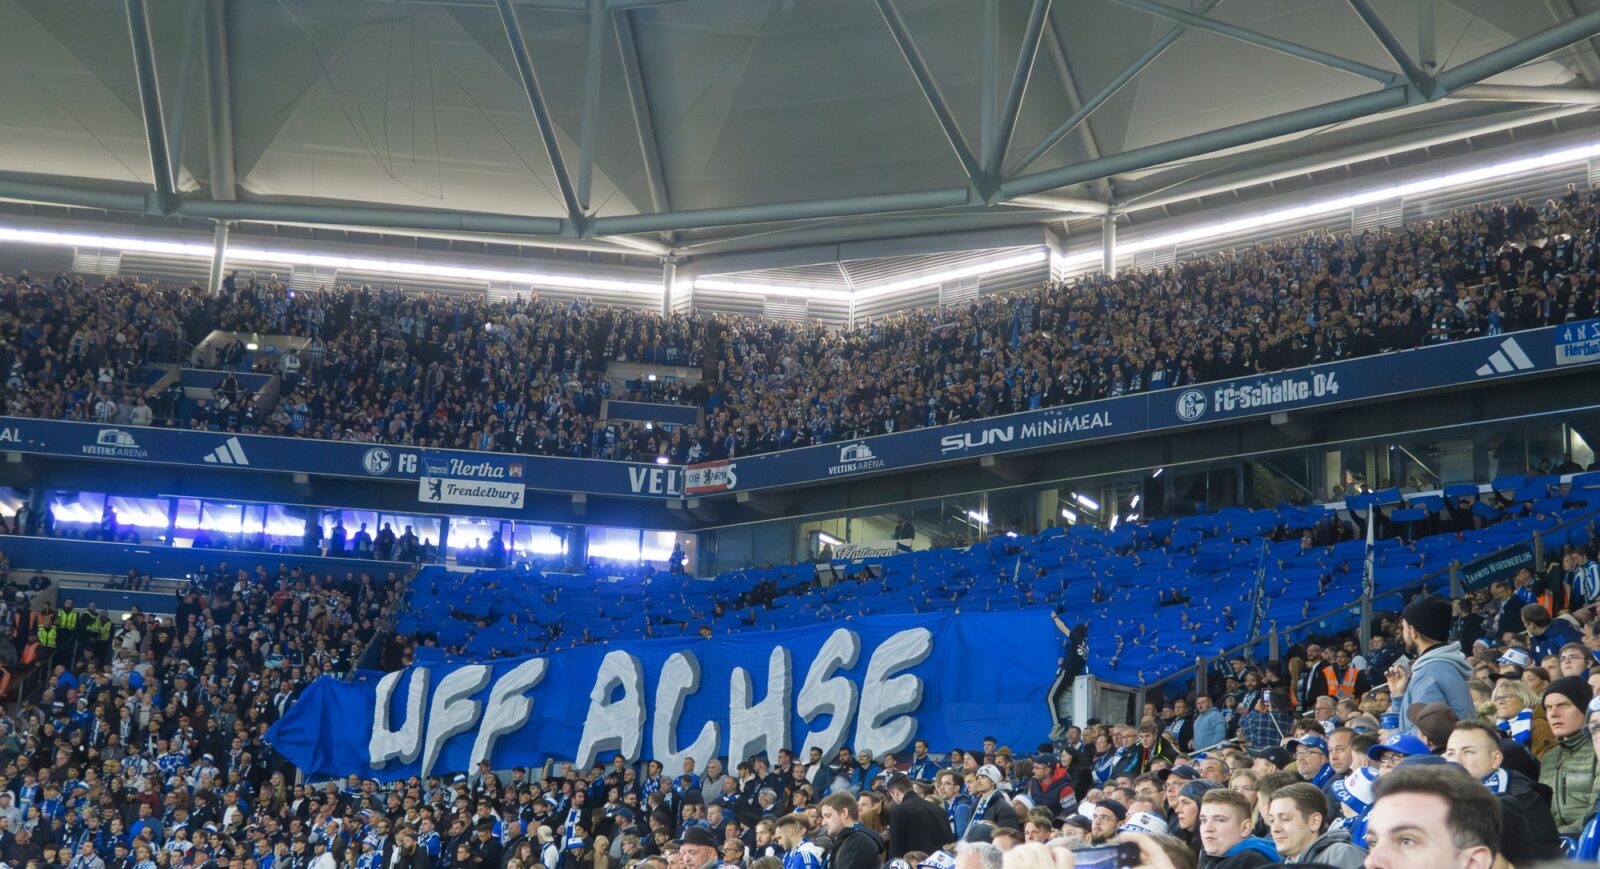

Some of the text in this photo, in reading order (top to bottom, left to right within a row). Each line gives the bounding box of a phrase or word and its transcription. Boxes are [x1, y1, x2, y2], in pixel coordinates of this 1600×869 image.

[1313, 371, 1339, 397] 04
[941, 426, 1013, 452] SUN
[116, 448, 149, 458] ARENA
[398, 454, 418, 474] FC
[450, 458, 505, 478] Hertha
[828, 459, 885, 475] VELTINS ARENA
[447, 484, 519, 505] Trendelburg
[368, 627, 933, 780] UFF ACHSE
